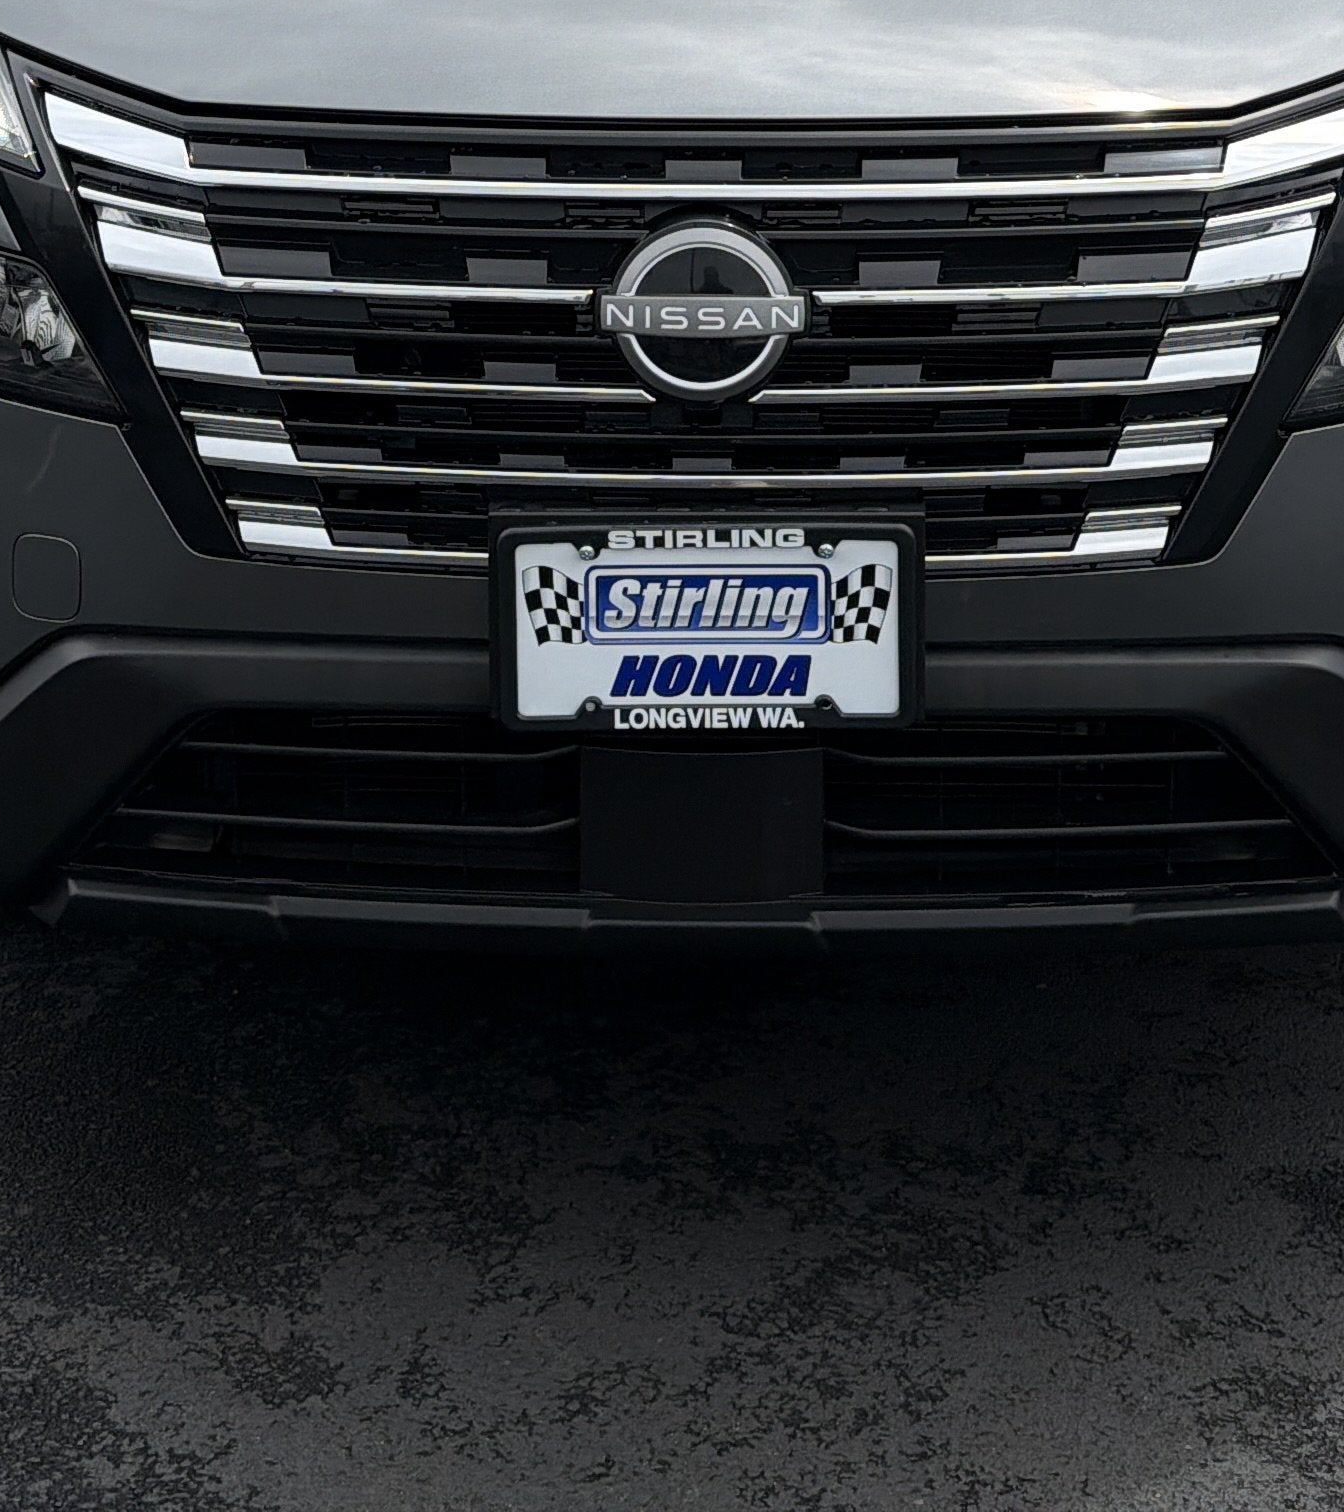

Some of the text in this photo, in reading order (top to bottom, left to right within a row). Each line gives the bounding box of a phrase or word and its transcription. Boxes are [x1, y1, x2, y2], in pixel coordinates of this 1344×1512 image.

[606, 302, 800, 331] NISSAN
[606, 528, 805, 550] STIRLING
[602, 577, 811, 635] Stirling
[610, 655, 812, 697] HONDA
[613, 706, 806, 730] LONGVIEW WA.
